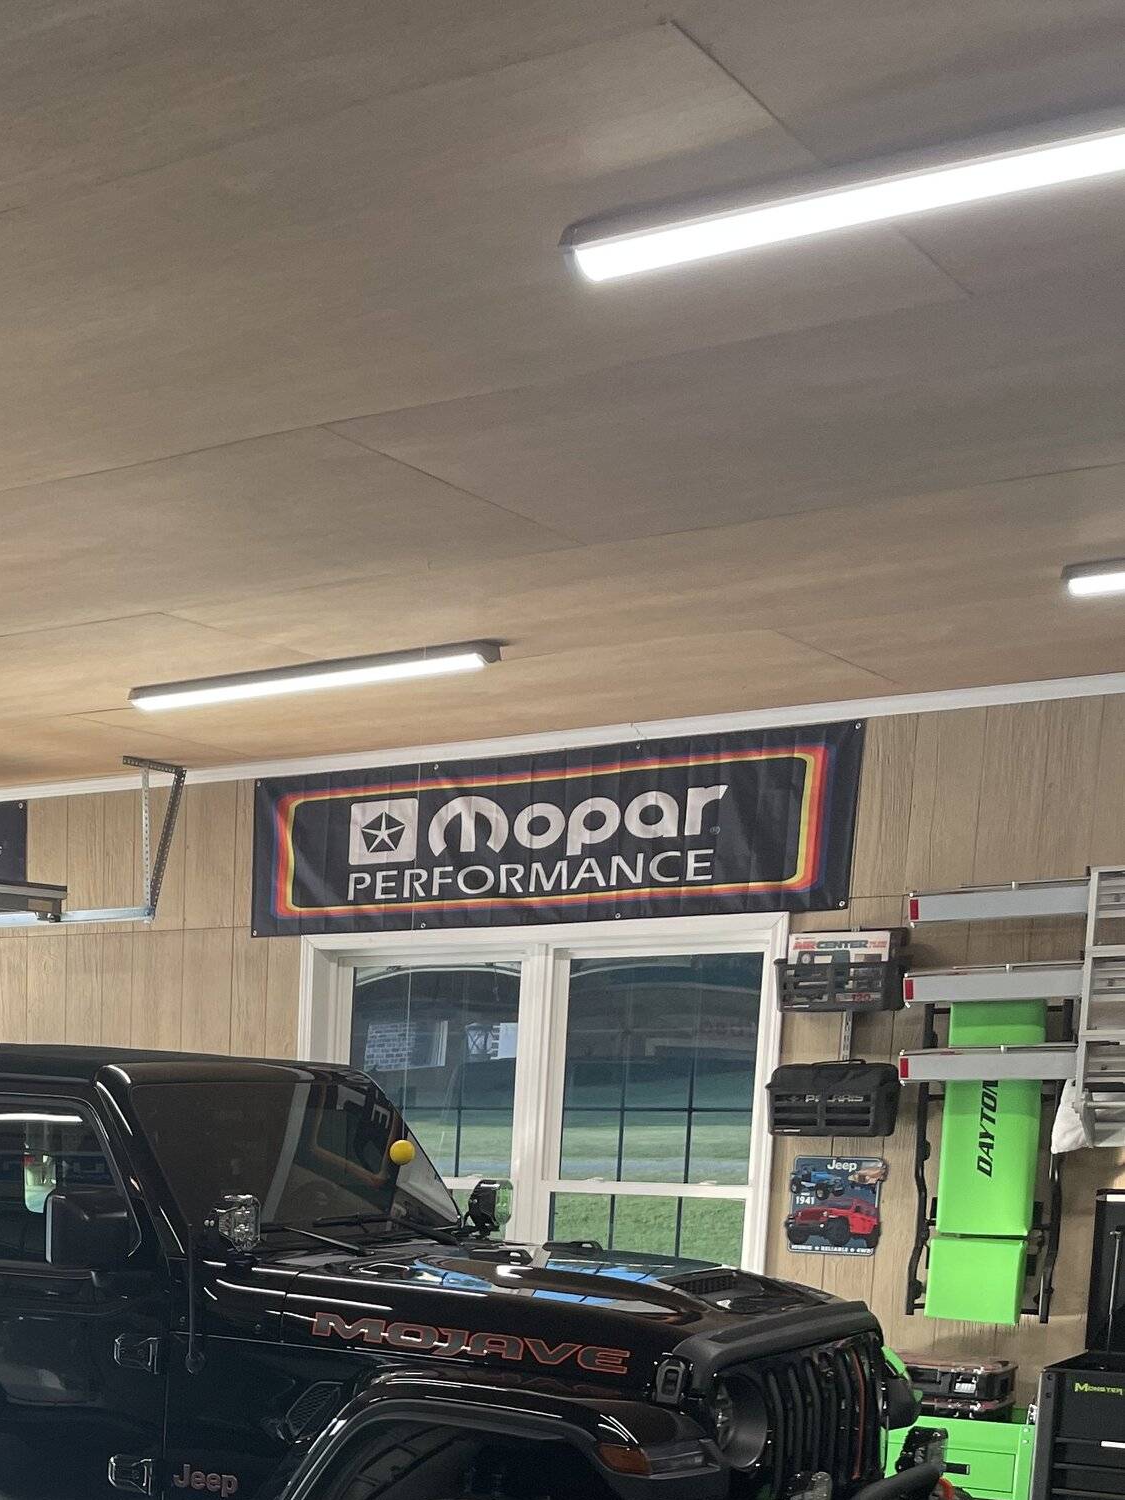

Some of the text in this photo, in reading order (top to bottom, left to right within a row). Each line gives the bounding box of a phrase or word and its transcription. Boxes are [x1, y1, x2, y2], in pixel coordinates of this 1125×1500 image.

[428, 784, 728, 857] Mopar
[347, 849, 714, 900] PERFORMANCE
[816, 939, 869, 949] CENTER
[827, 1160, 857, 1172] Jeep
[796, 1196, 815, 1205] 1941
[312, 1312, 631, 1374] MOJAVE
[173, 1463, 238, 1498] Jeep
